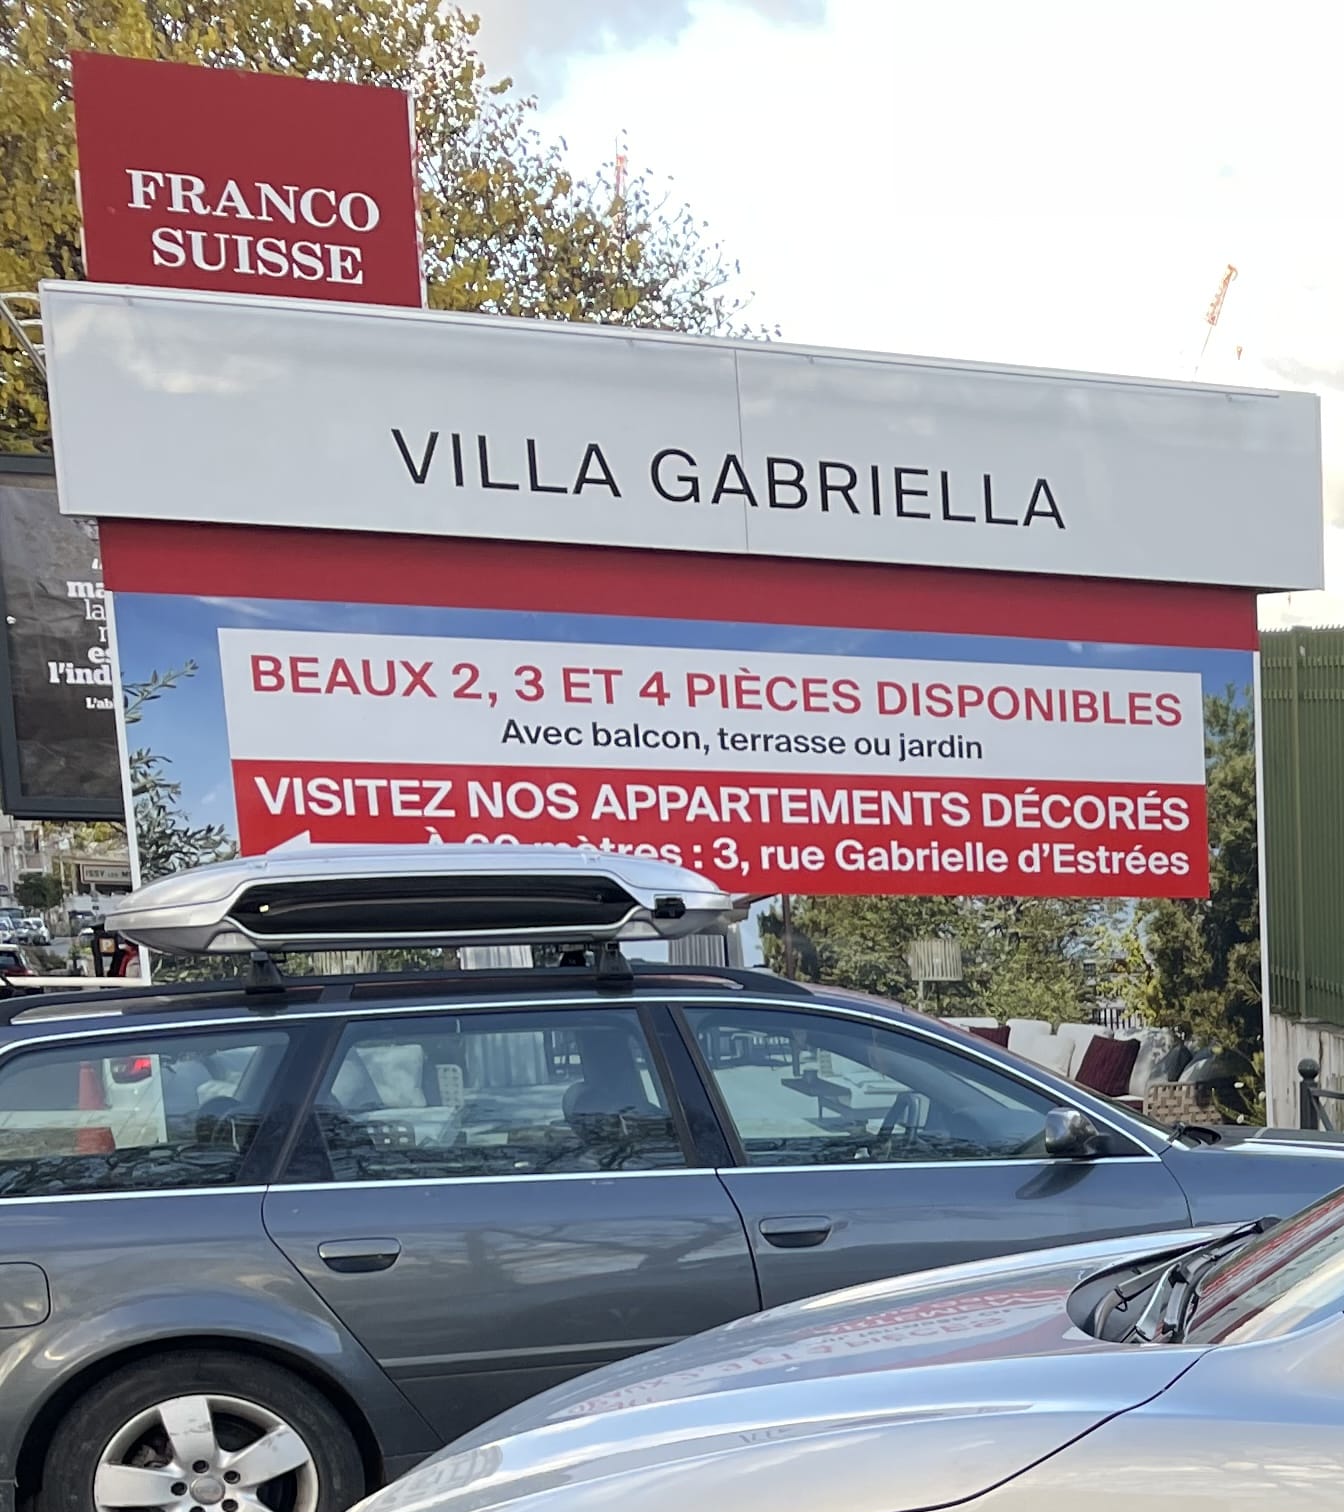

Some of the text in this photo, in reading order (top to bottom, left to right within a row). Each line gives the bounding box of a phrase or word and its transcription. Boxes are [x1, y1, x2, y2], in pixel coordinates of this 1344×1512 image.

[126, 169, 380, 232] FRANCO
[151, 228, 364, 285] SUISSE
[391, 428, 1066, 530] VILLA GABRIELLA
[251, 655, 1182, 727] BEAUX 2, 3 ET 4 PIÈCES DISPONIBLES
[501, 719, 983, 761] Avec balcon, terrasse ou jardin
[254, 777, 1189, 832] VISITEZ NOS APPARTEMENTS DÉCORÉS
[534, 835, 682, 868] ètres
[760, 843, 825, 872] rue
[835, 838, 1008, 873] Gabrielle
